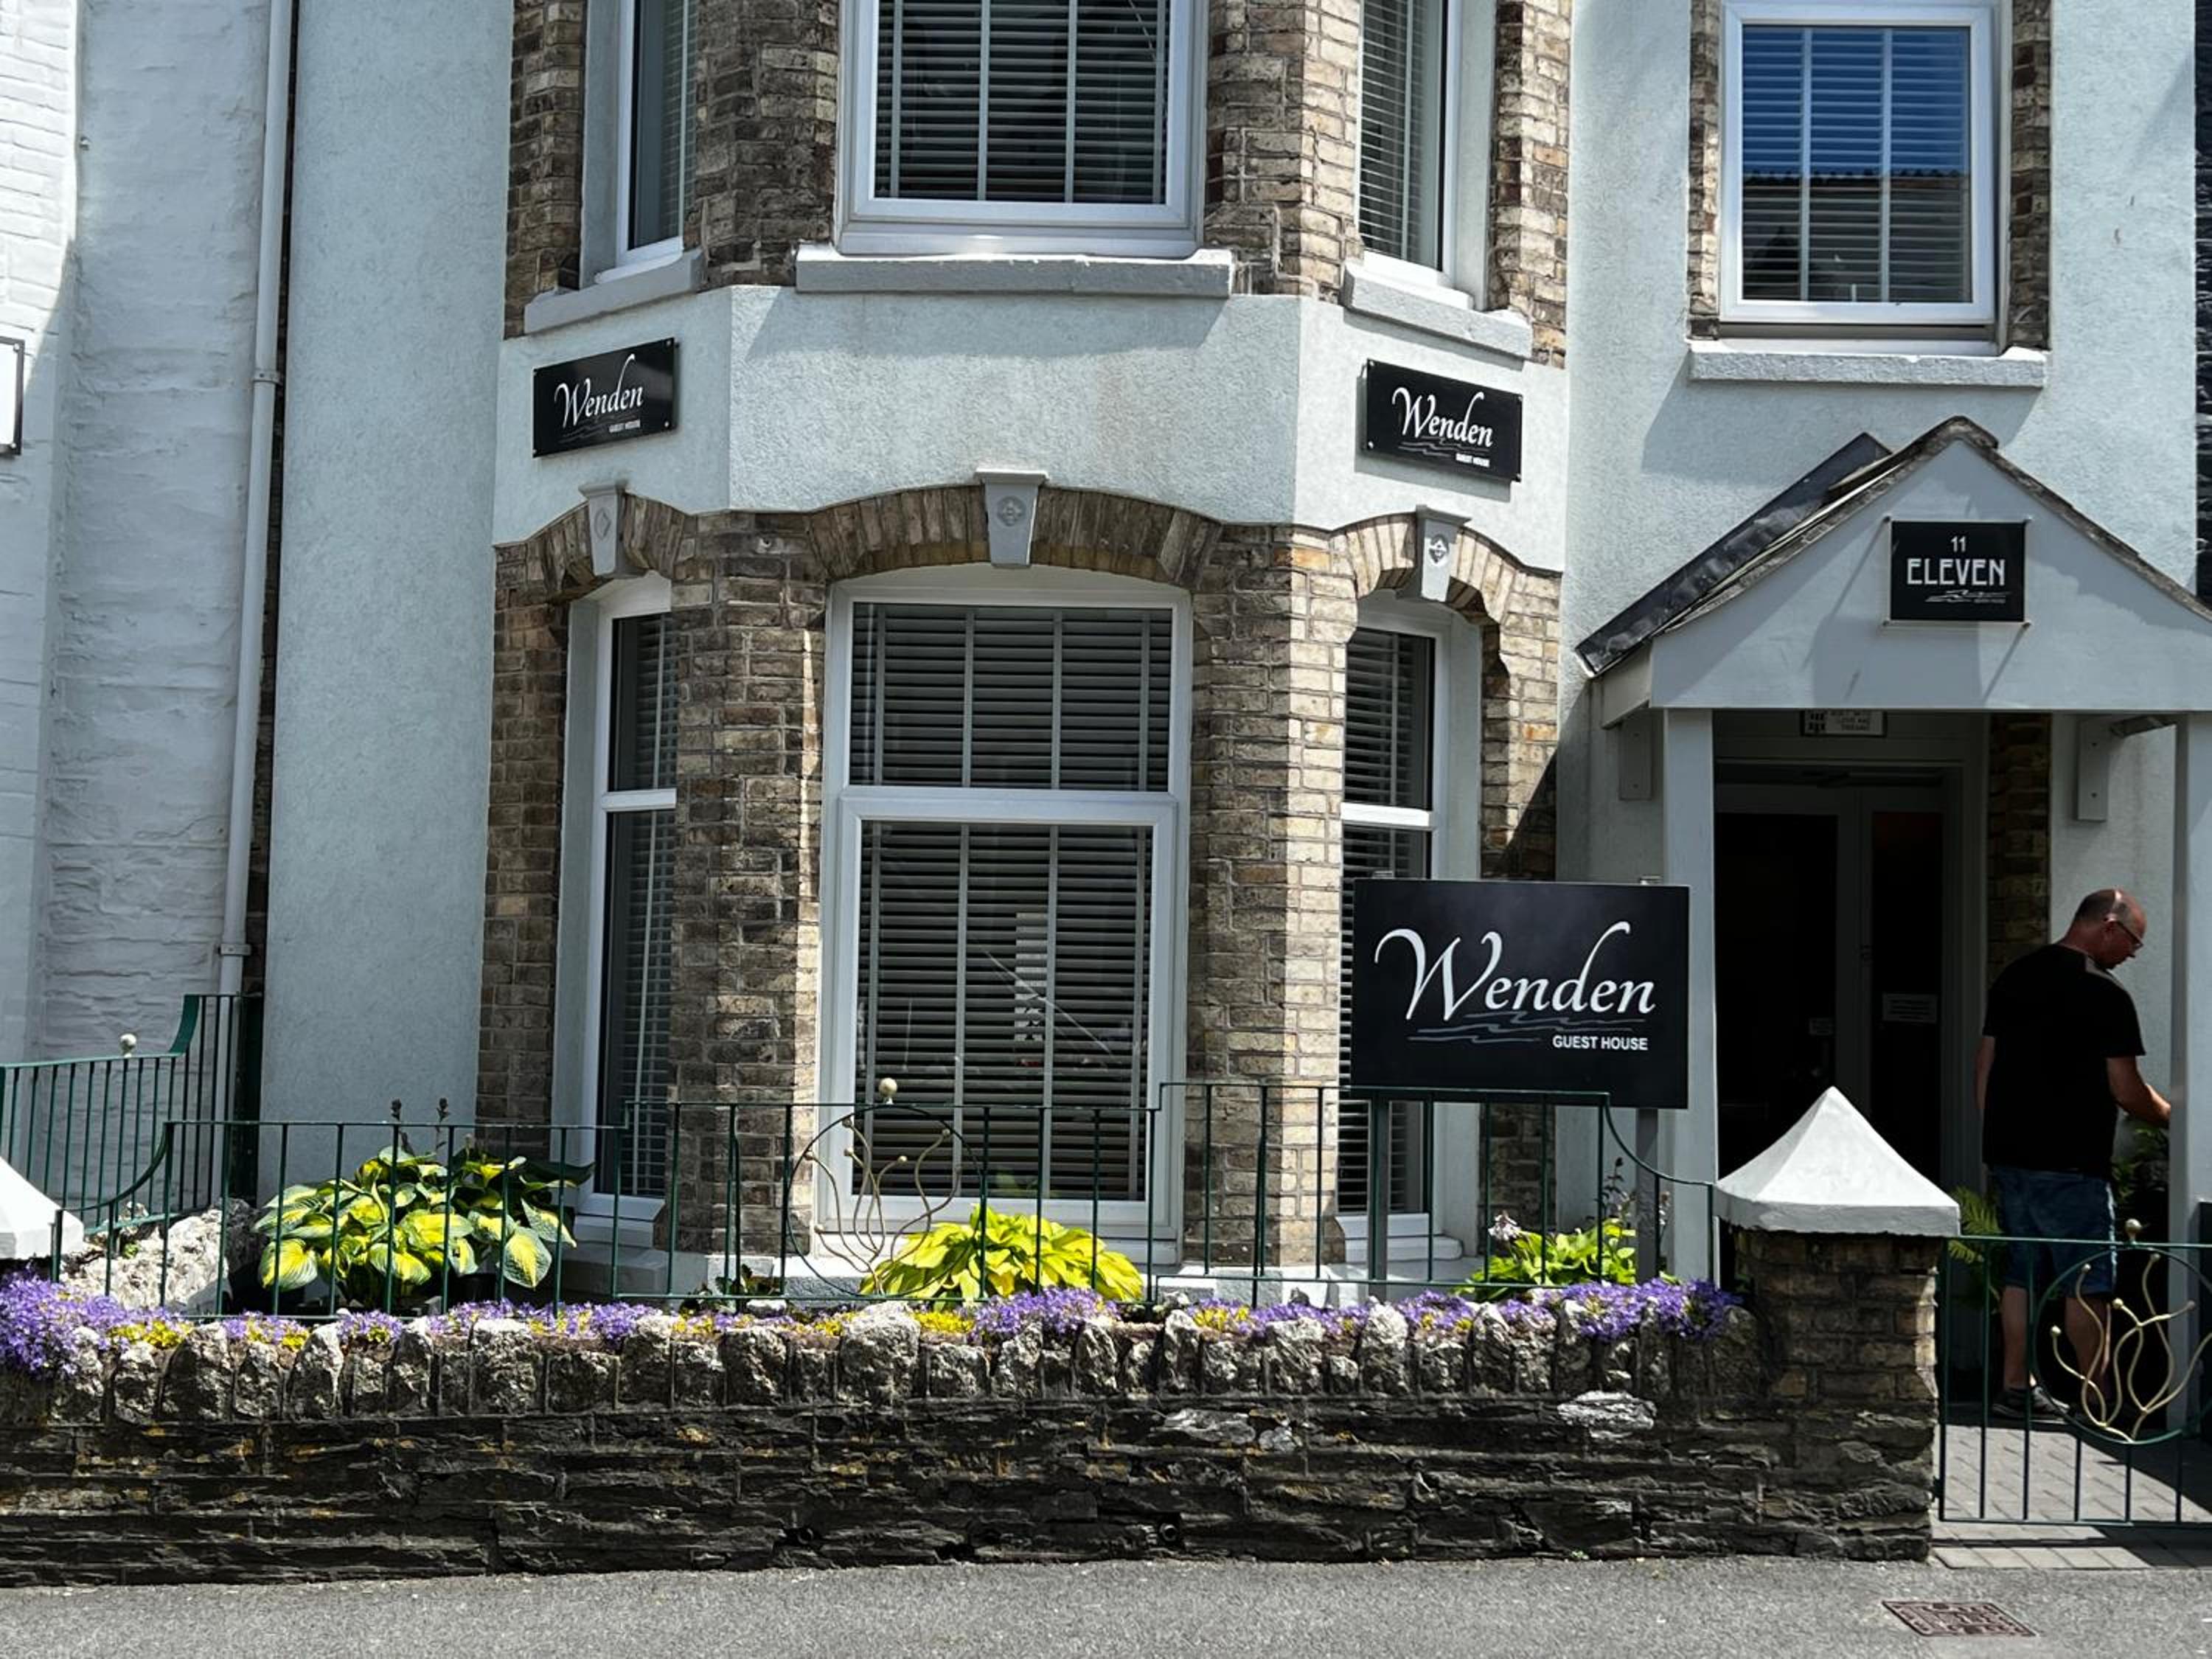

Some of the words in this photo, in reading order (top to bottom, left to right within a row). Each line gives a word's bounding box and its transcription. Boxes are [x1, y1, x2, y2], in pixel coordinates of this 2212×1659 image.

[554, 353, 644, 428] Wenden
[1391, 386, 1493, 448] Wenden
[1950, 536, 1966, 552] 11
[1907, 558, 2006, 585] ELEVEN
[1374, 921, 1656, 1021] Wenden
[1552, 1034, 1599, 1049] GUEST
[1601, 1036, 1649, 1051] HOUSE
